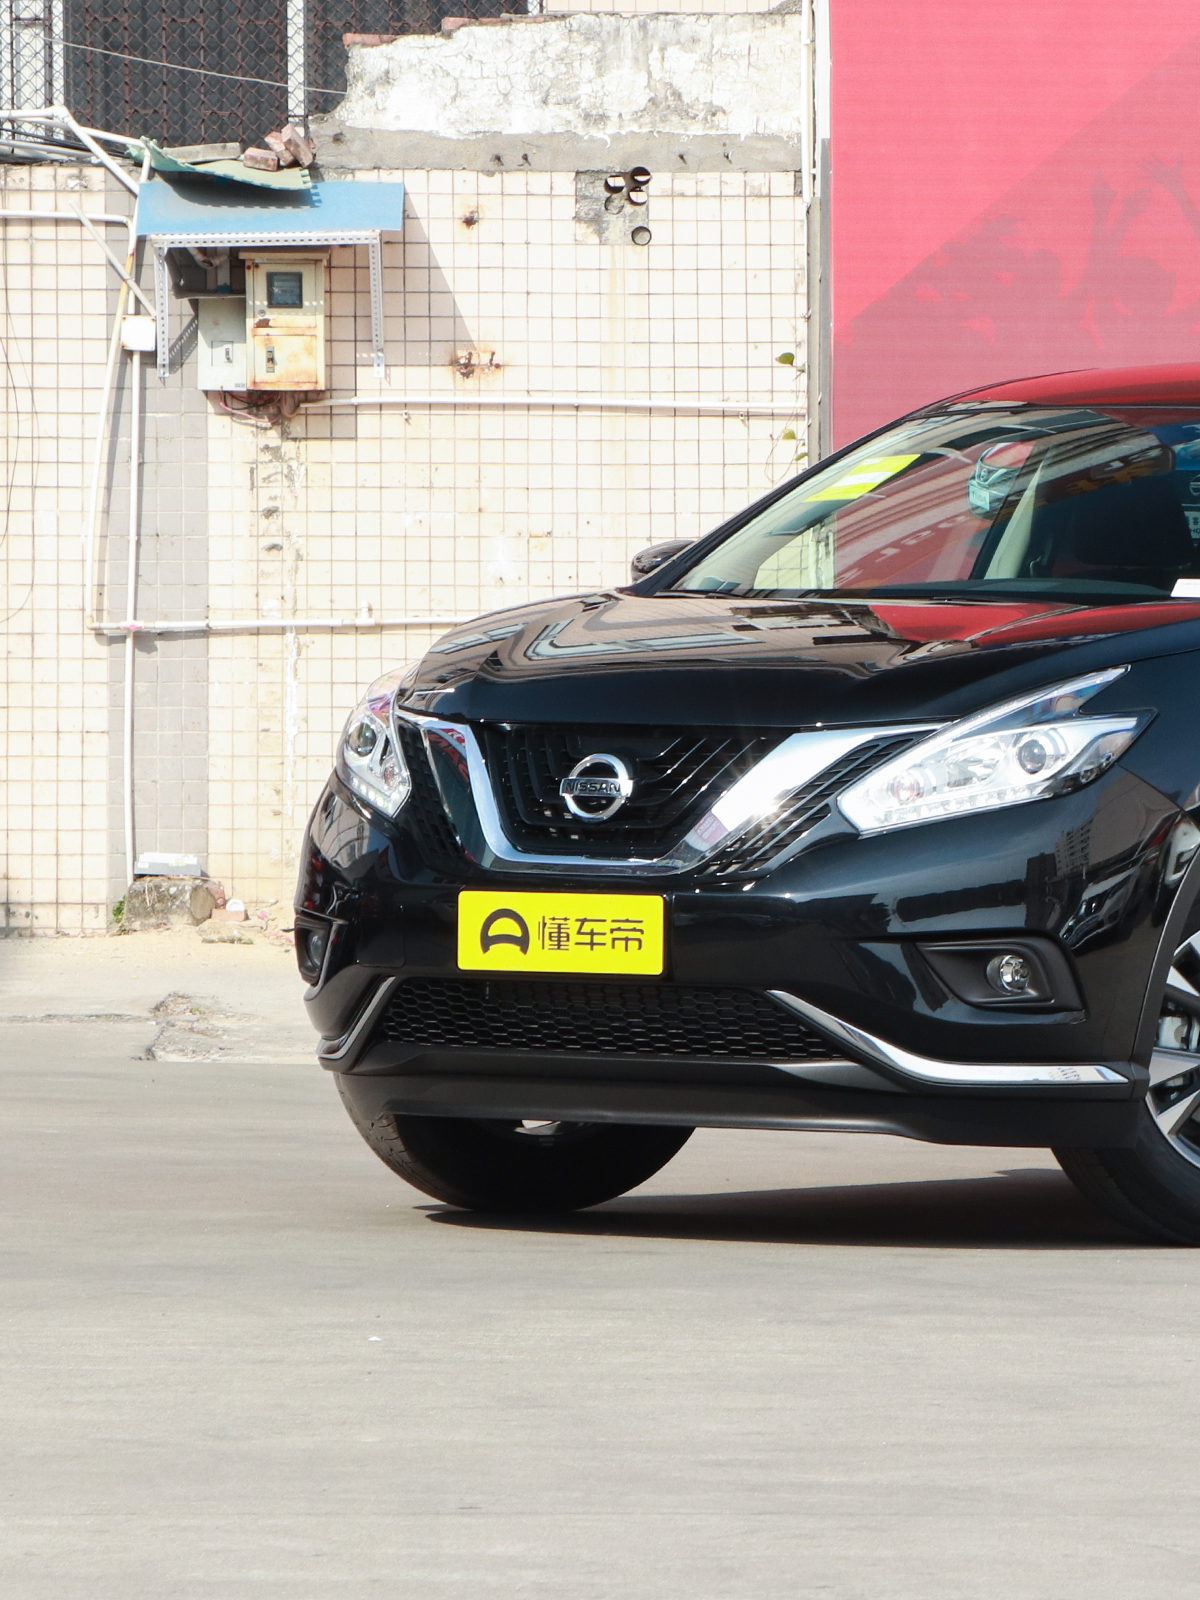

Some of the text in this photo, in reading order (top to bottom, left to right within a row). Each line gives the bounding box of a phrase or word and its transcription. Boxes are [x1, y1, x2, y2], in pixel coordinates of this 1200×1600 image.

[564, 781, 621, 793] NISSAN
[538, 915, 644, 952] 懂车帝
